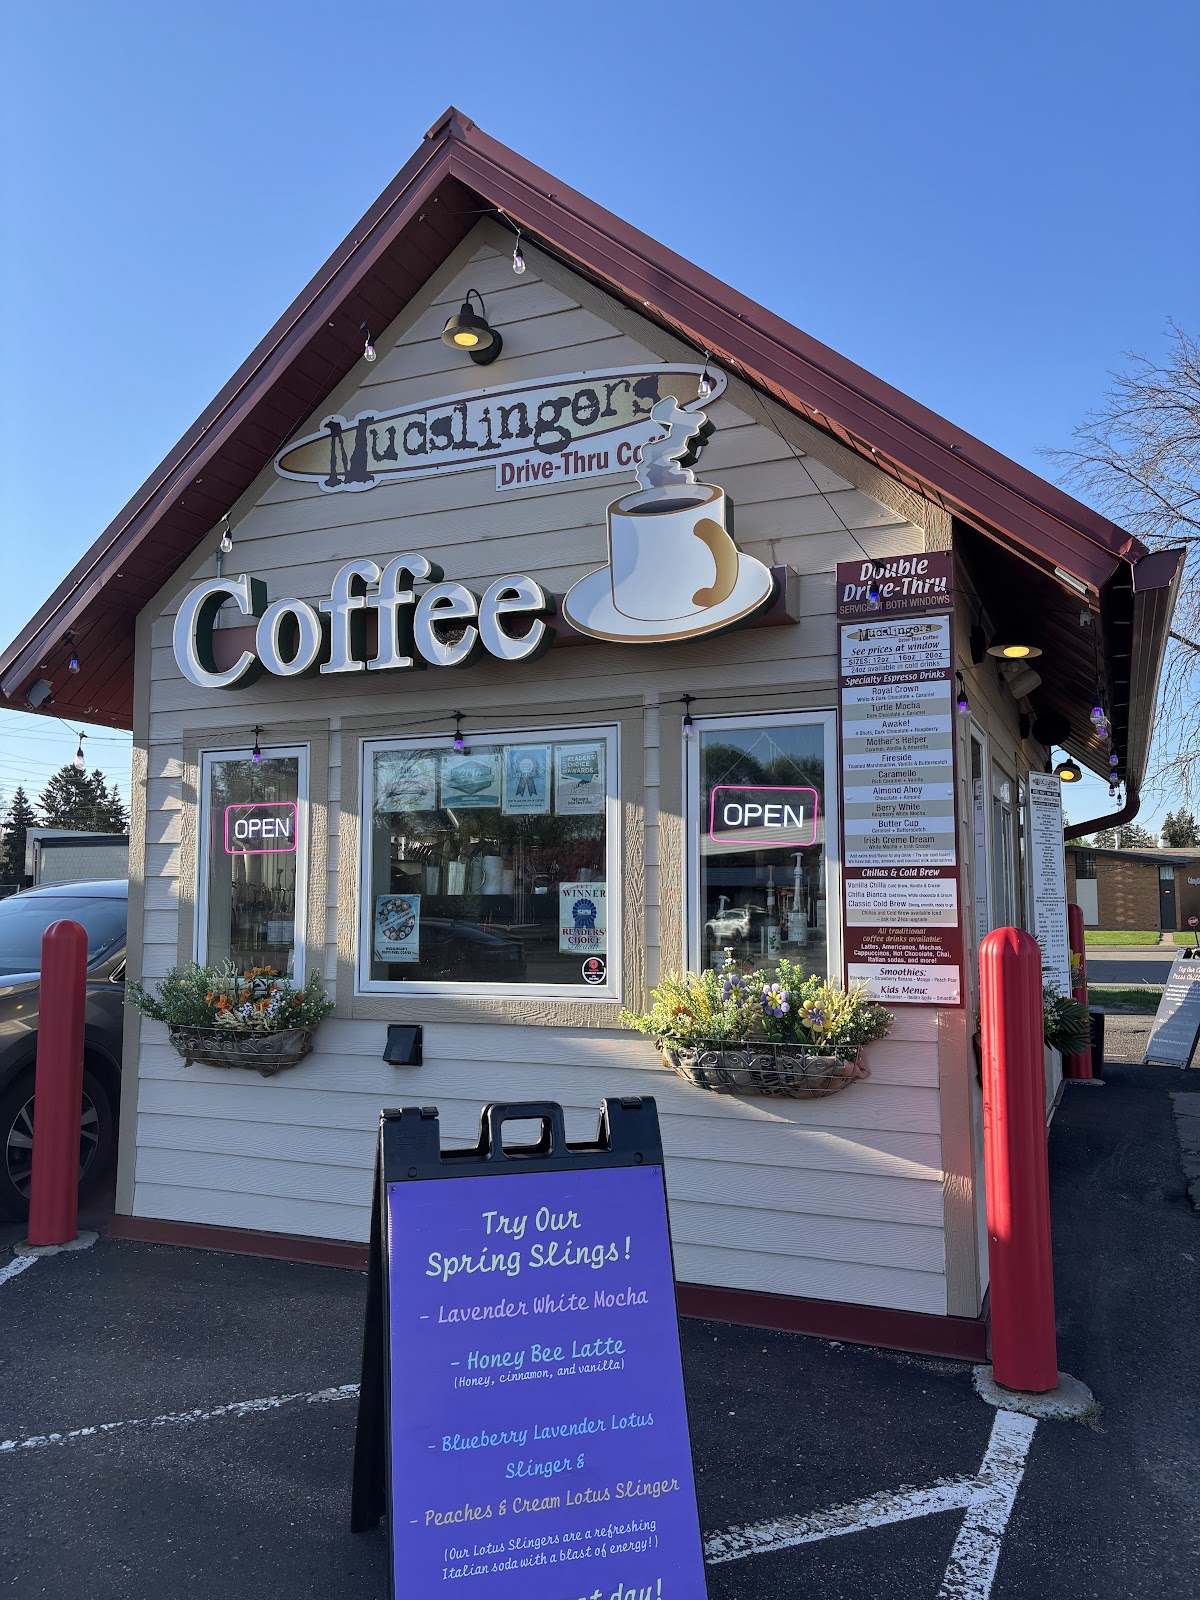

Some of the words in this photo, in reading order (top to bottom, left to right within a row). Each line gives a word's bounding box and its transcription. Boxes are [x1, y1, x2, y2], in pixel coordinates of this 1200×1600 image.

[324, 375, 660, 486] Mudslingers
[501, 449, 608, 486] Drive-Thru
[860, 558, 928, 581] Double
[886, 600, 907, 610] BOTH
[910, 595, 950, 607] WINDOWS
[173, 552, 548, 688] Coffee
[868, 646, 892, 655] prices
[908, 642, 939, 650] window
[846, 676, 881, 686] Specialty
[884, 674, 917, 683] Espresso
[920, 671, 945, 679] Drinks
[872, 687, 892, 695] Royal
[867, 738, 899, 746] Mother's
[879, 770, 916, 778] Caramello
[904, 786, 922, 794] Ahoy
[724, 804, 803, 827] OPEN
[876, 804, 896, 812] Berry
[234, 818, 290, 839] OPEN
[880, 968, 926, 976] Smoothies:
[482, 1210, 527, 1240] Try
[536, 1207, 581, 1231] Our
[426, 1248, 520, 1282] Spring
[529, 1236, 631, 1269] Slings!
[438, 1298, 528, 1323] Lavender
[534, 1292, 589, 1315] White
[594, 1287, 648, 1309] Mocha
[468, 1350, 525, 1370] Honey
[531, 1344, 564, 1363] Bee
[572, 1337, 625, 1359] Latte
[454, 1374, 494, 1389] (Honey,
[499, 1368, 553, 1383] cinnamon,
[557, 1364, 576, 1376] and
[578, 1358, 624, 1373] vanilla)
[442, 1429, 527, 1451] Blueberry
[534, 1417, 606, 1440] Lavender
[611, 1412, 654, 1430] Lotus
[505, 1456, 572, 1479] Slinger
[576, 1453, 584, 1469] &
[425, 1505, 492, 1527] Peaches
[499, 1500, 506, 1516] &
[512, 1494, 561, 1514] Cream
[566, 1486, 610, 1507] Lotus
[615, 1477, 680, 1499] Slinger
[444, 1547, 470, 1562] (Our
[473, 1542, 505, 1557] Lotus
[508, 1534, 560, 1551] Slingers
[563, 1531, 583, 1543] are
[585, 1530, 592, 1539] a
[594, 1518, 656, 1539] refreshing
[442, 1563, 489, 1580] Italian
[491, 1558, 519, 1572] soda
[520, 1553, 548, 1568] with
[550, 1554, 557, 1563] a
[560, 1547, 592, 1562] blast
[594, 1543, 607, 1559] of
[610, 1535, 658, 1554] energy!)
